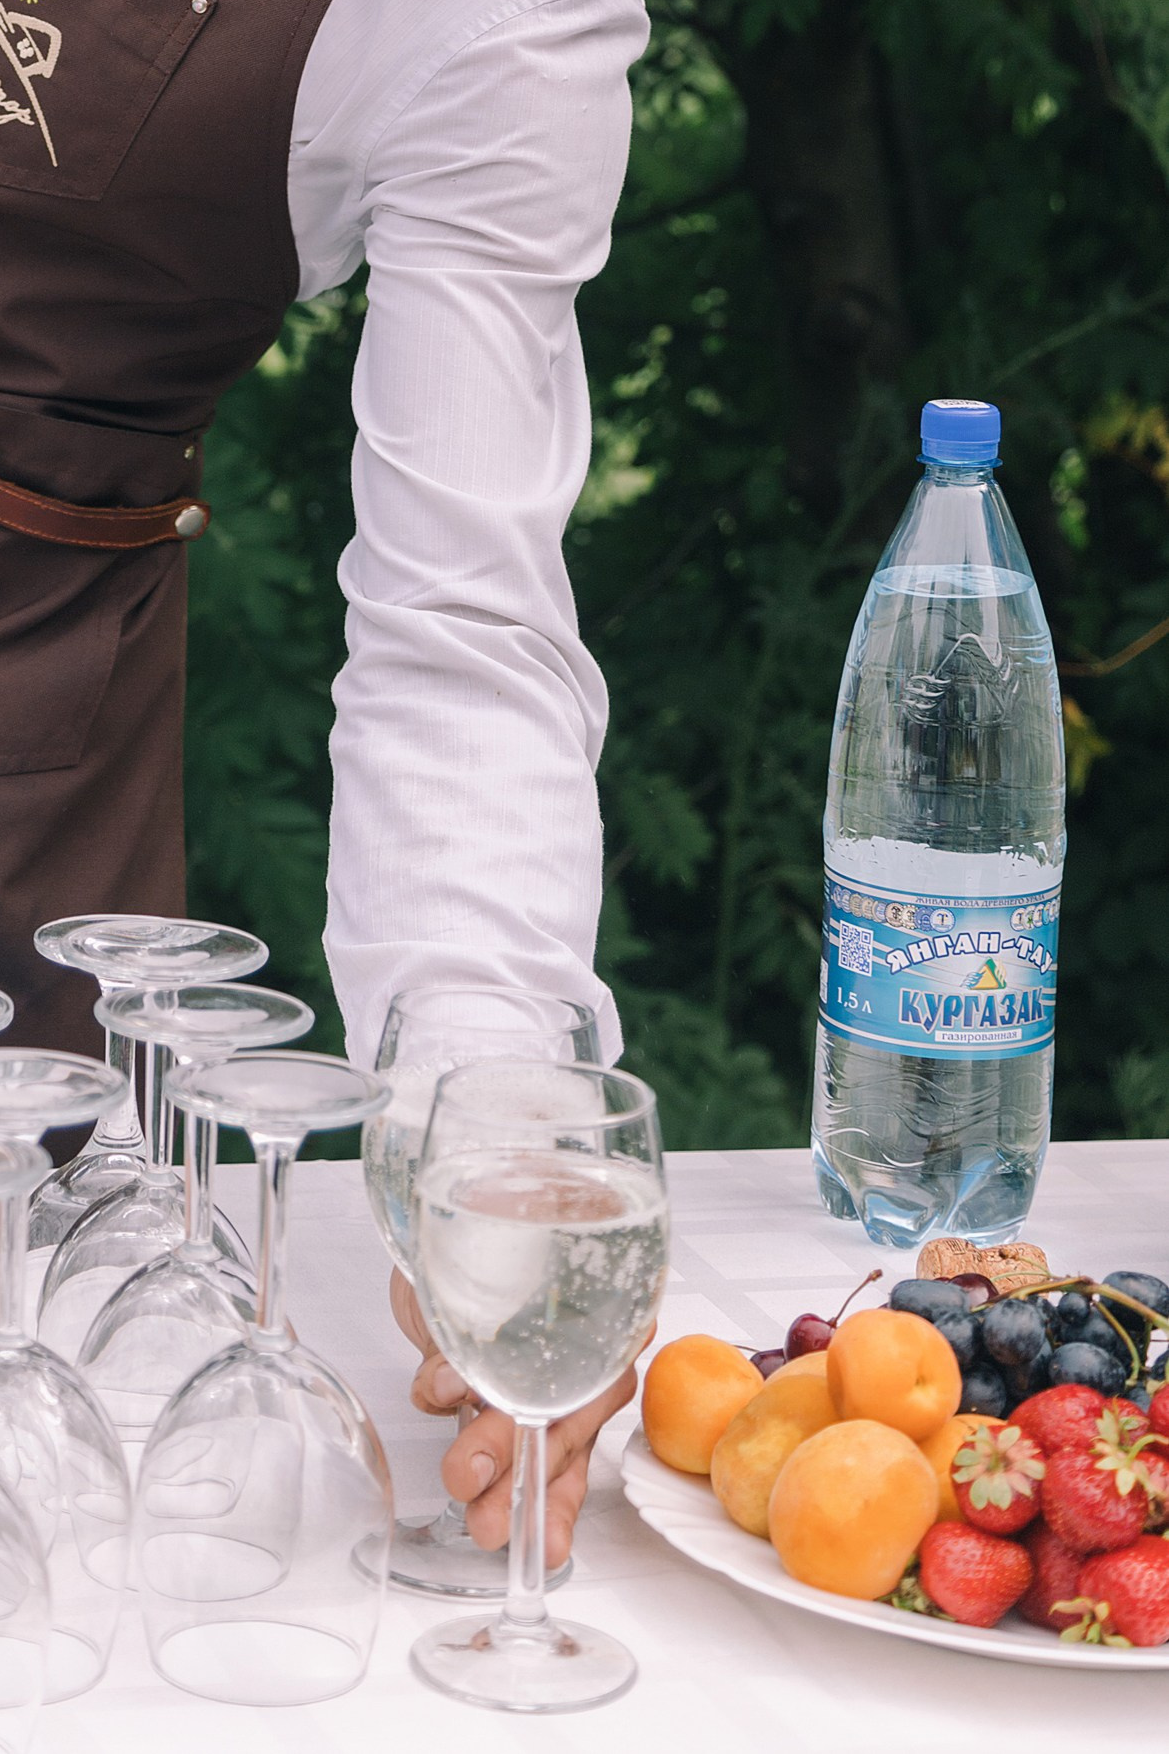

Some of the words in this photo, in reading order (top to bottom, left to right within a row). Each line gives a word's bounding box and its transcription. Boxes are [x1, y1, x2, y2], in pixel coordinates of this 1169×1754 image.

[915, 896, 951, 907] ЖИВАЯ
[953, 899, 980, 908] ВОДА
[886, 932, 1053, 974] ЯНГАН-ТАУ
[837, 986, 859, 1009] 1,5
[900, 987, 1044, 1032] КУРГАЗАК
[941, 1030, 1018, 1043] газированная
